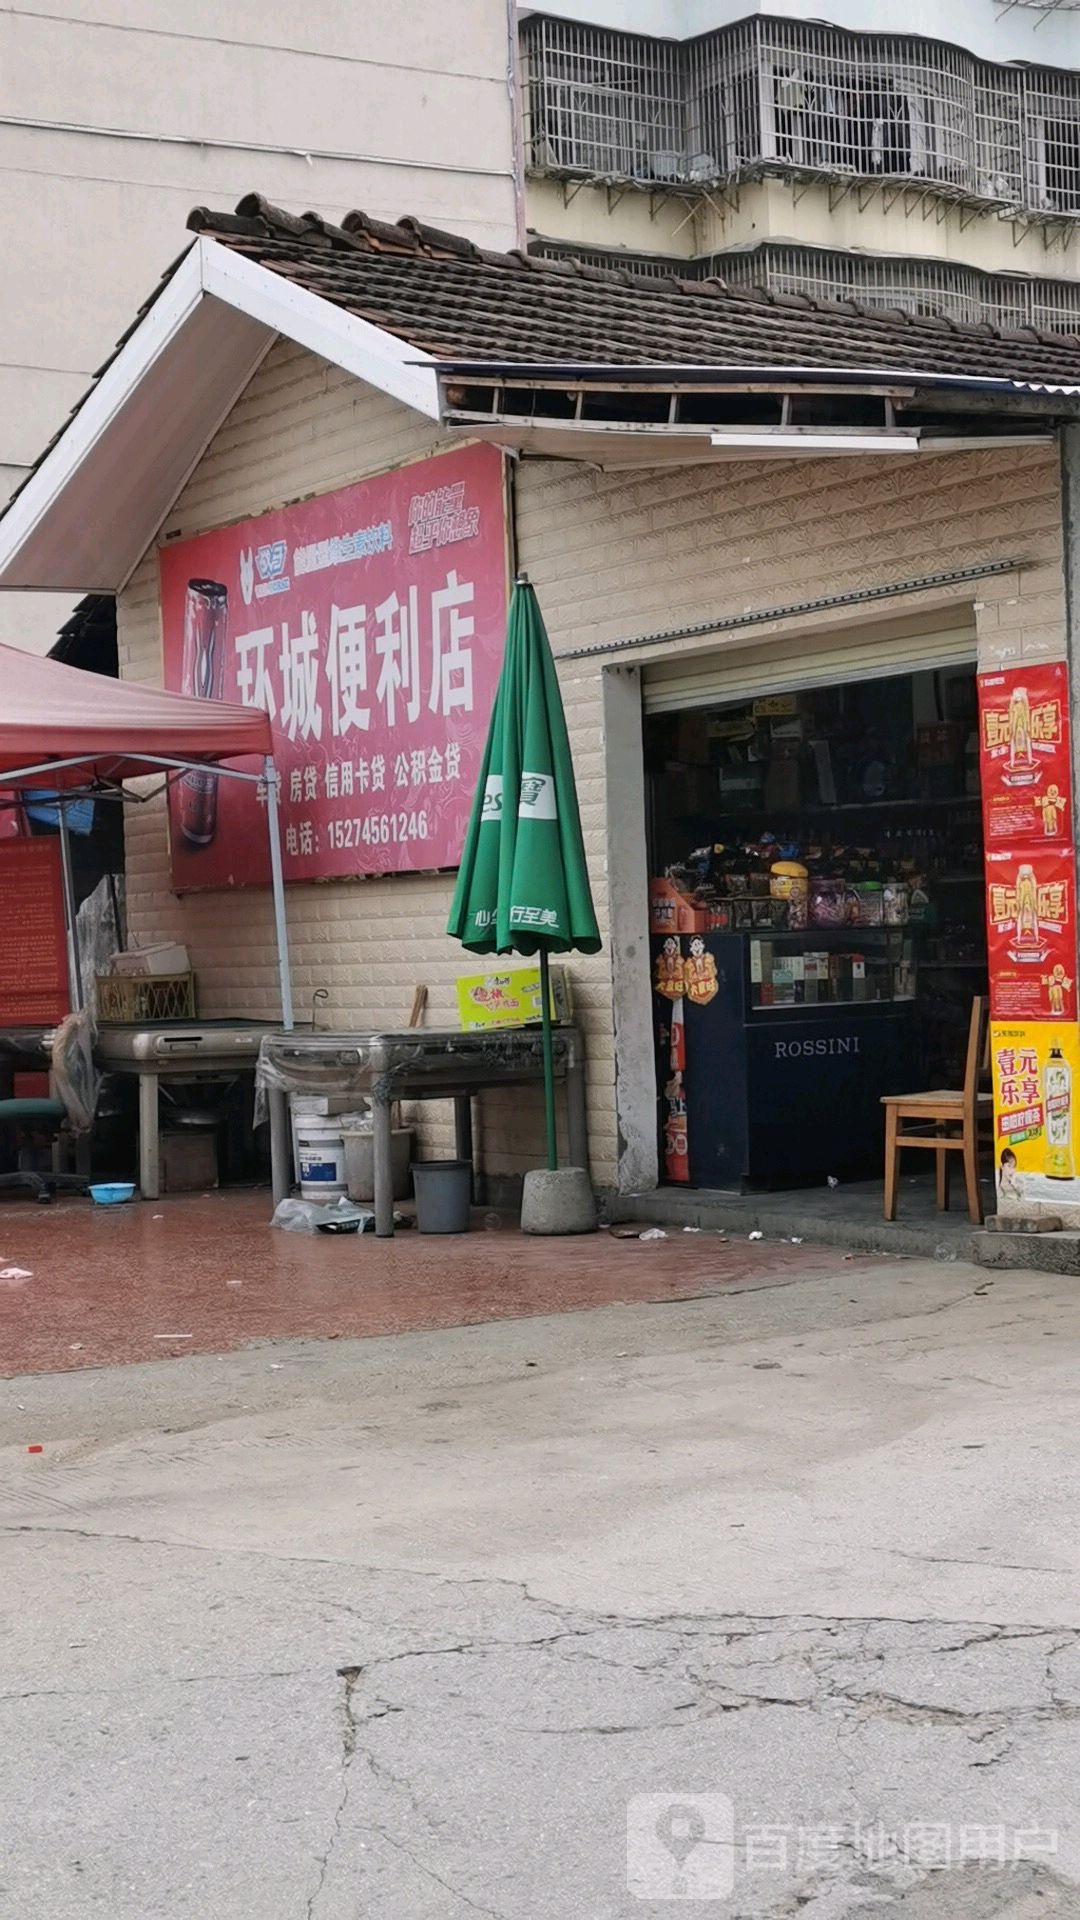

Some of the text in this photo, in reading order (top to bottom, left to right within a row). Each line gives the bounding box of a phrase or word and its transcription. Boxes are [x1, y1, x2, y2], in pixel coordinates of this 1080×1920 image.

[234, 569, 475, 742] 环城便利店
[290, 767, 317, 802] 房贷
[324, 754, 385, 799] 信用卡贷
[395, 742, 461, 787] 公积金贷
[327, 810, 428, 849] 15274561246
[510, 905, 559, 928] 行至美
[775, 1036, 860, 1058] ROSSINI
[997, 1048, 1037, 1077] 壹元
[1001, 1078, 1040, 1105] 乐享
